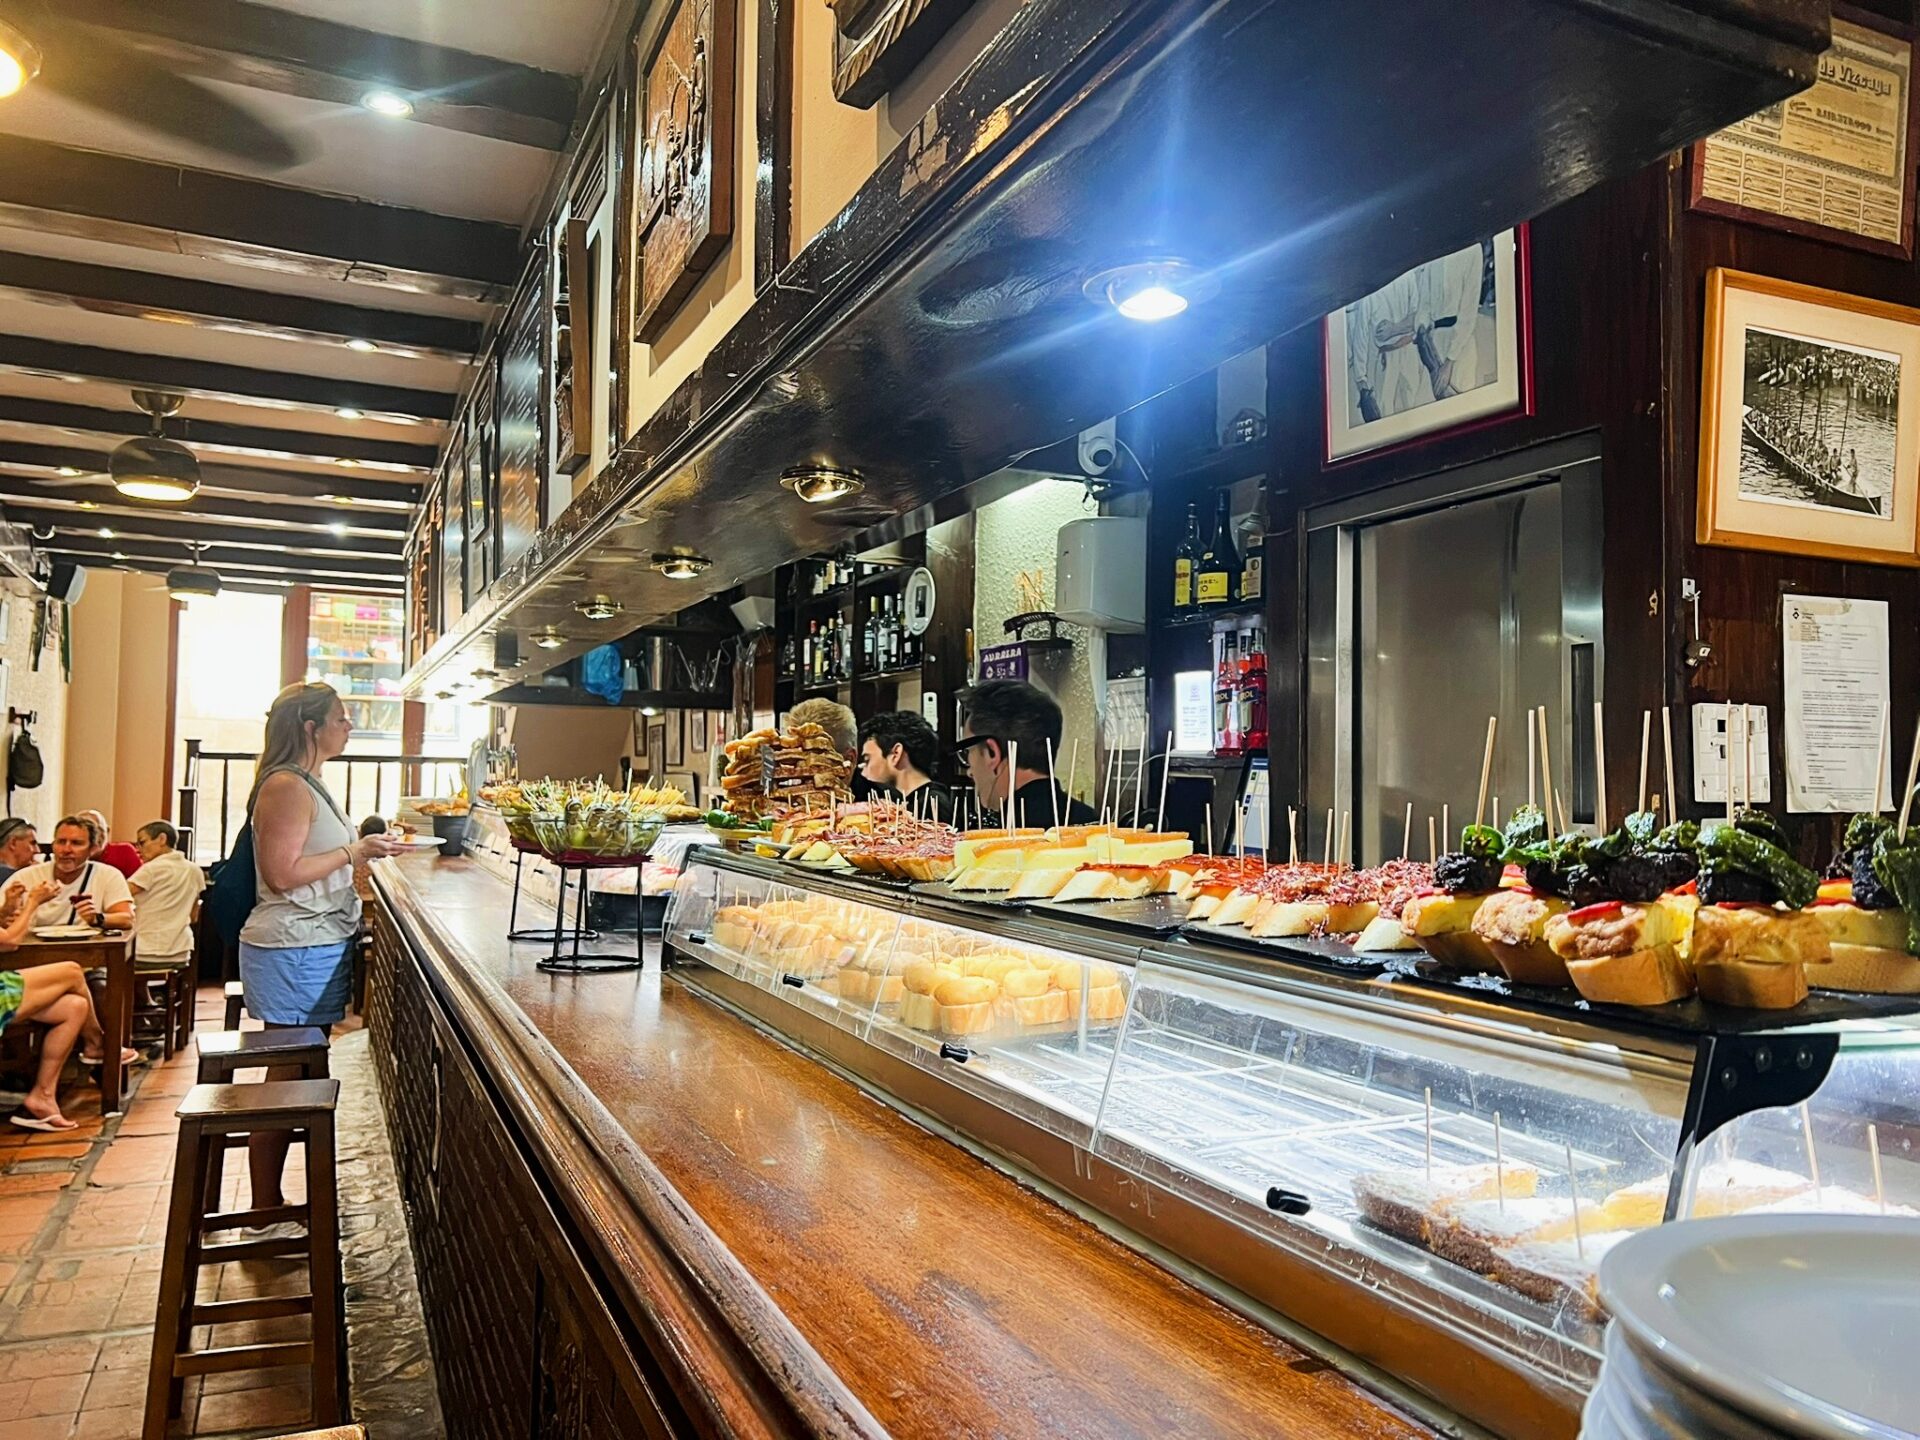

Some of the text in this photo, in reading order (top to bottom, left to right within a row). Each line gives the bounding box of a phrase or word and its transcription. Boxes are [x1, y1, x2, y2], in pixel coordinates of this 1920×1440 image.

[1819, 58, 1836, 78] de
[1839, 64, 1892, 97] Vizcaya
[982, 647, 1022, 663] AURRERA
